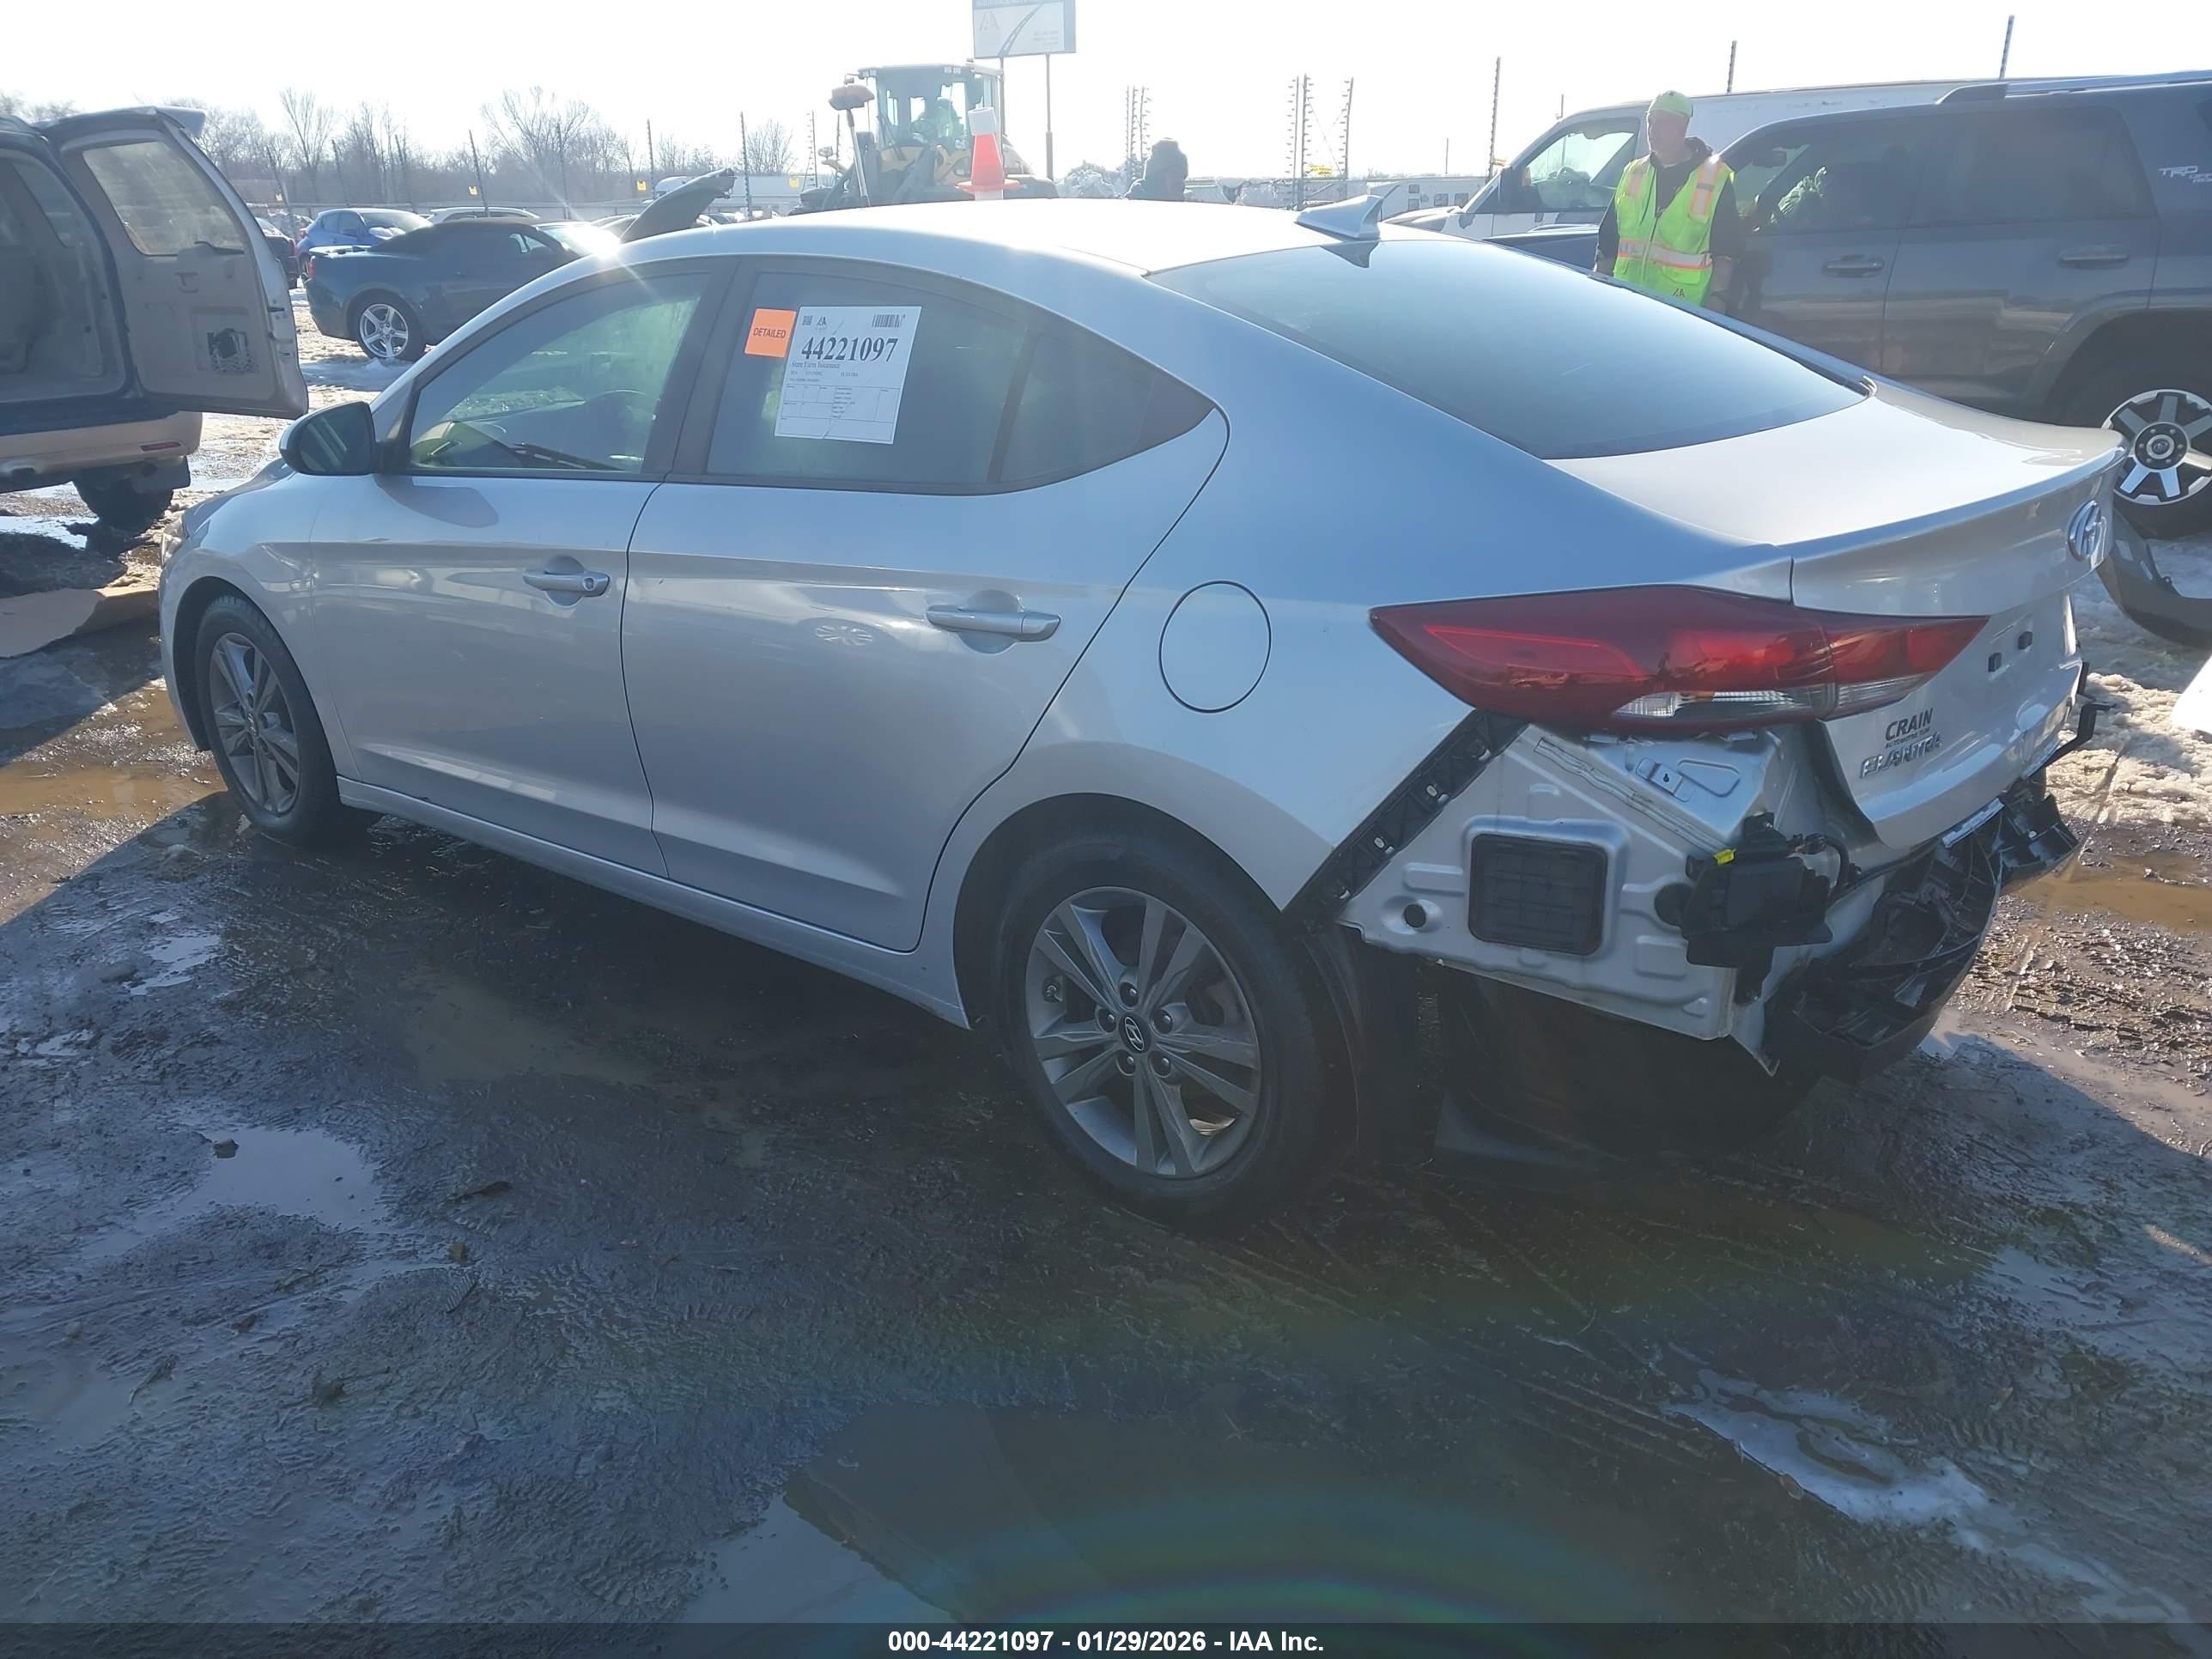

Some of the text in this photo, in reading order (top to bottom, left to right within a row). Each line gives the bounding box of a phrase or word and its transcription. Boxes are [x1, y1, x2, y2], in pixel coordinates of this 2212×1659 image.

[2158, 165, 2198, 178] TRD
[752, 327, 787, 338] DETAILED
[801, 336, 898, 362] 44221097
[1885, 707, 1933, 741] CRAIN
[1859, 732, 1942, 780] ELANTRA
